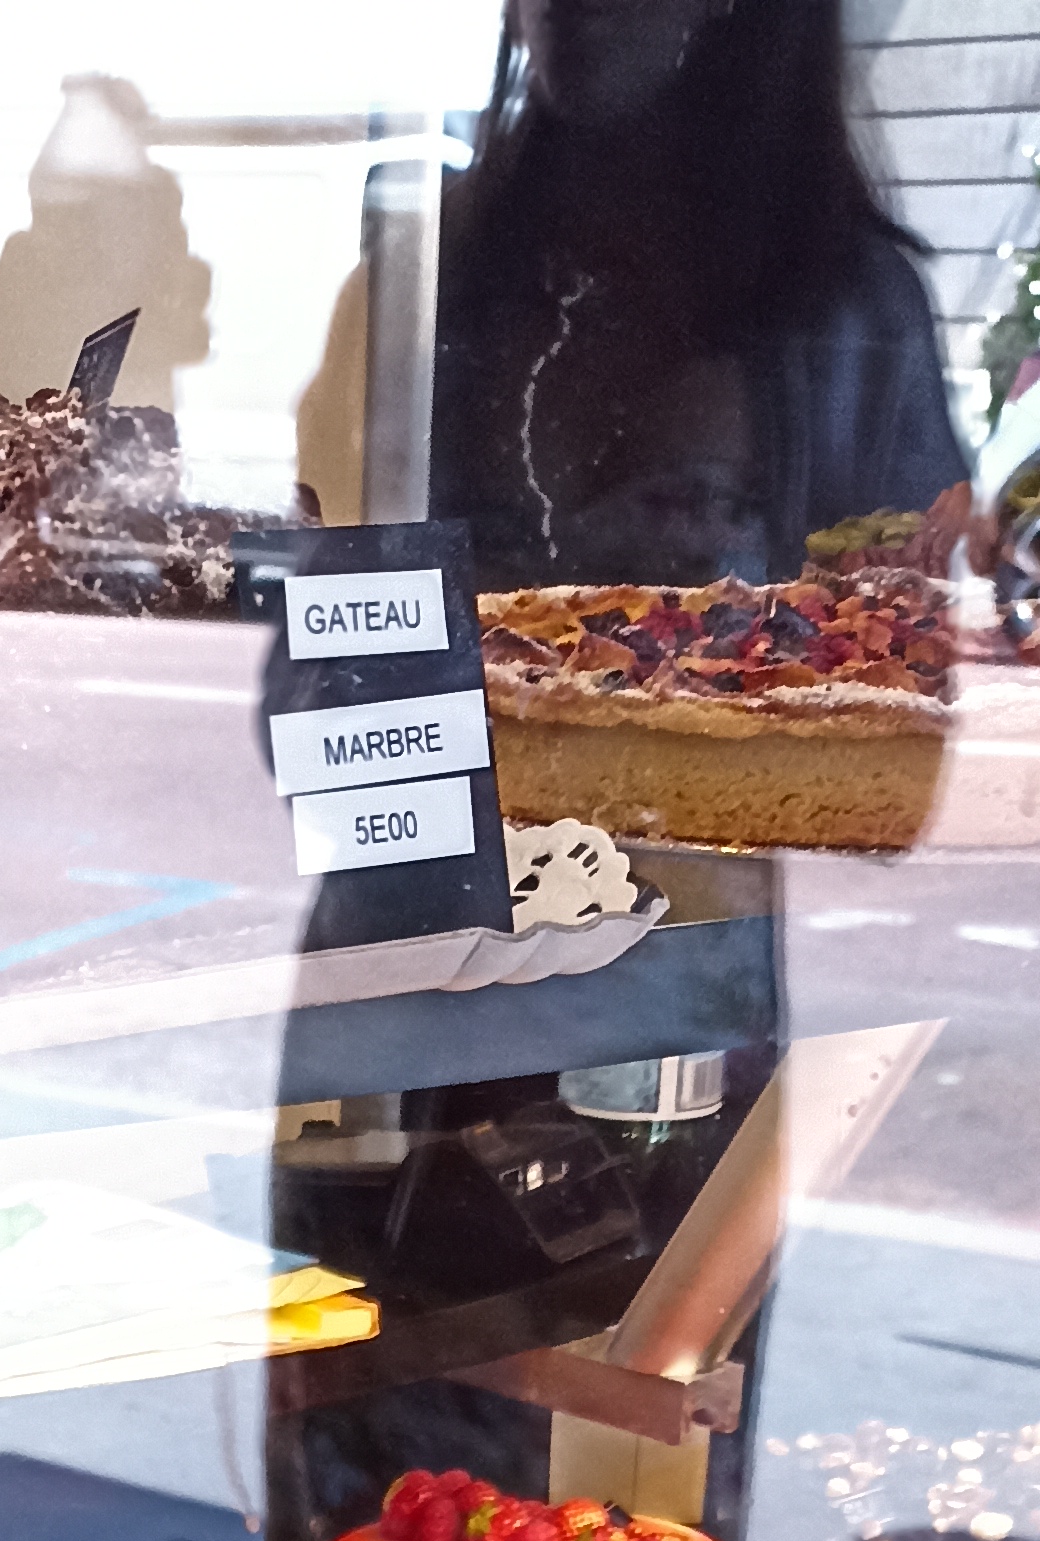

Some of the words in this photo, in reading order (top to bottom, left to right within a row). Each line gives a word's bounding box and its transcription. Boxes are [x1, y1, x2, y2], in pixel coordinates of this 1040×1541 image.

[305, 600, 420, 634] GATEAU
[324, 723, 443, 766] MARBRE
[355, 811, 417, 845] 5E00
